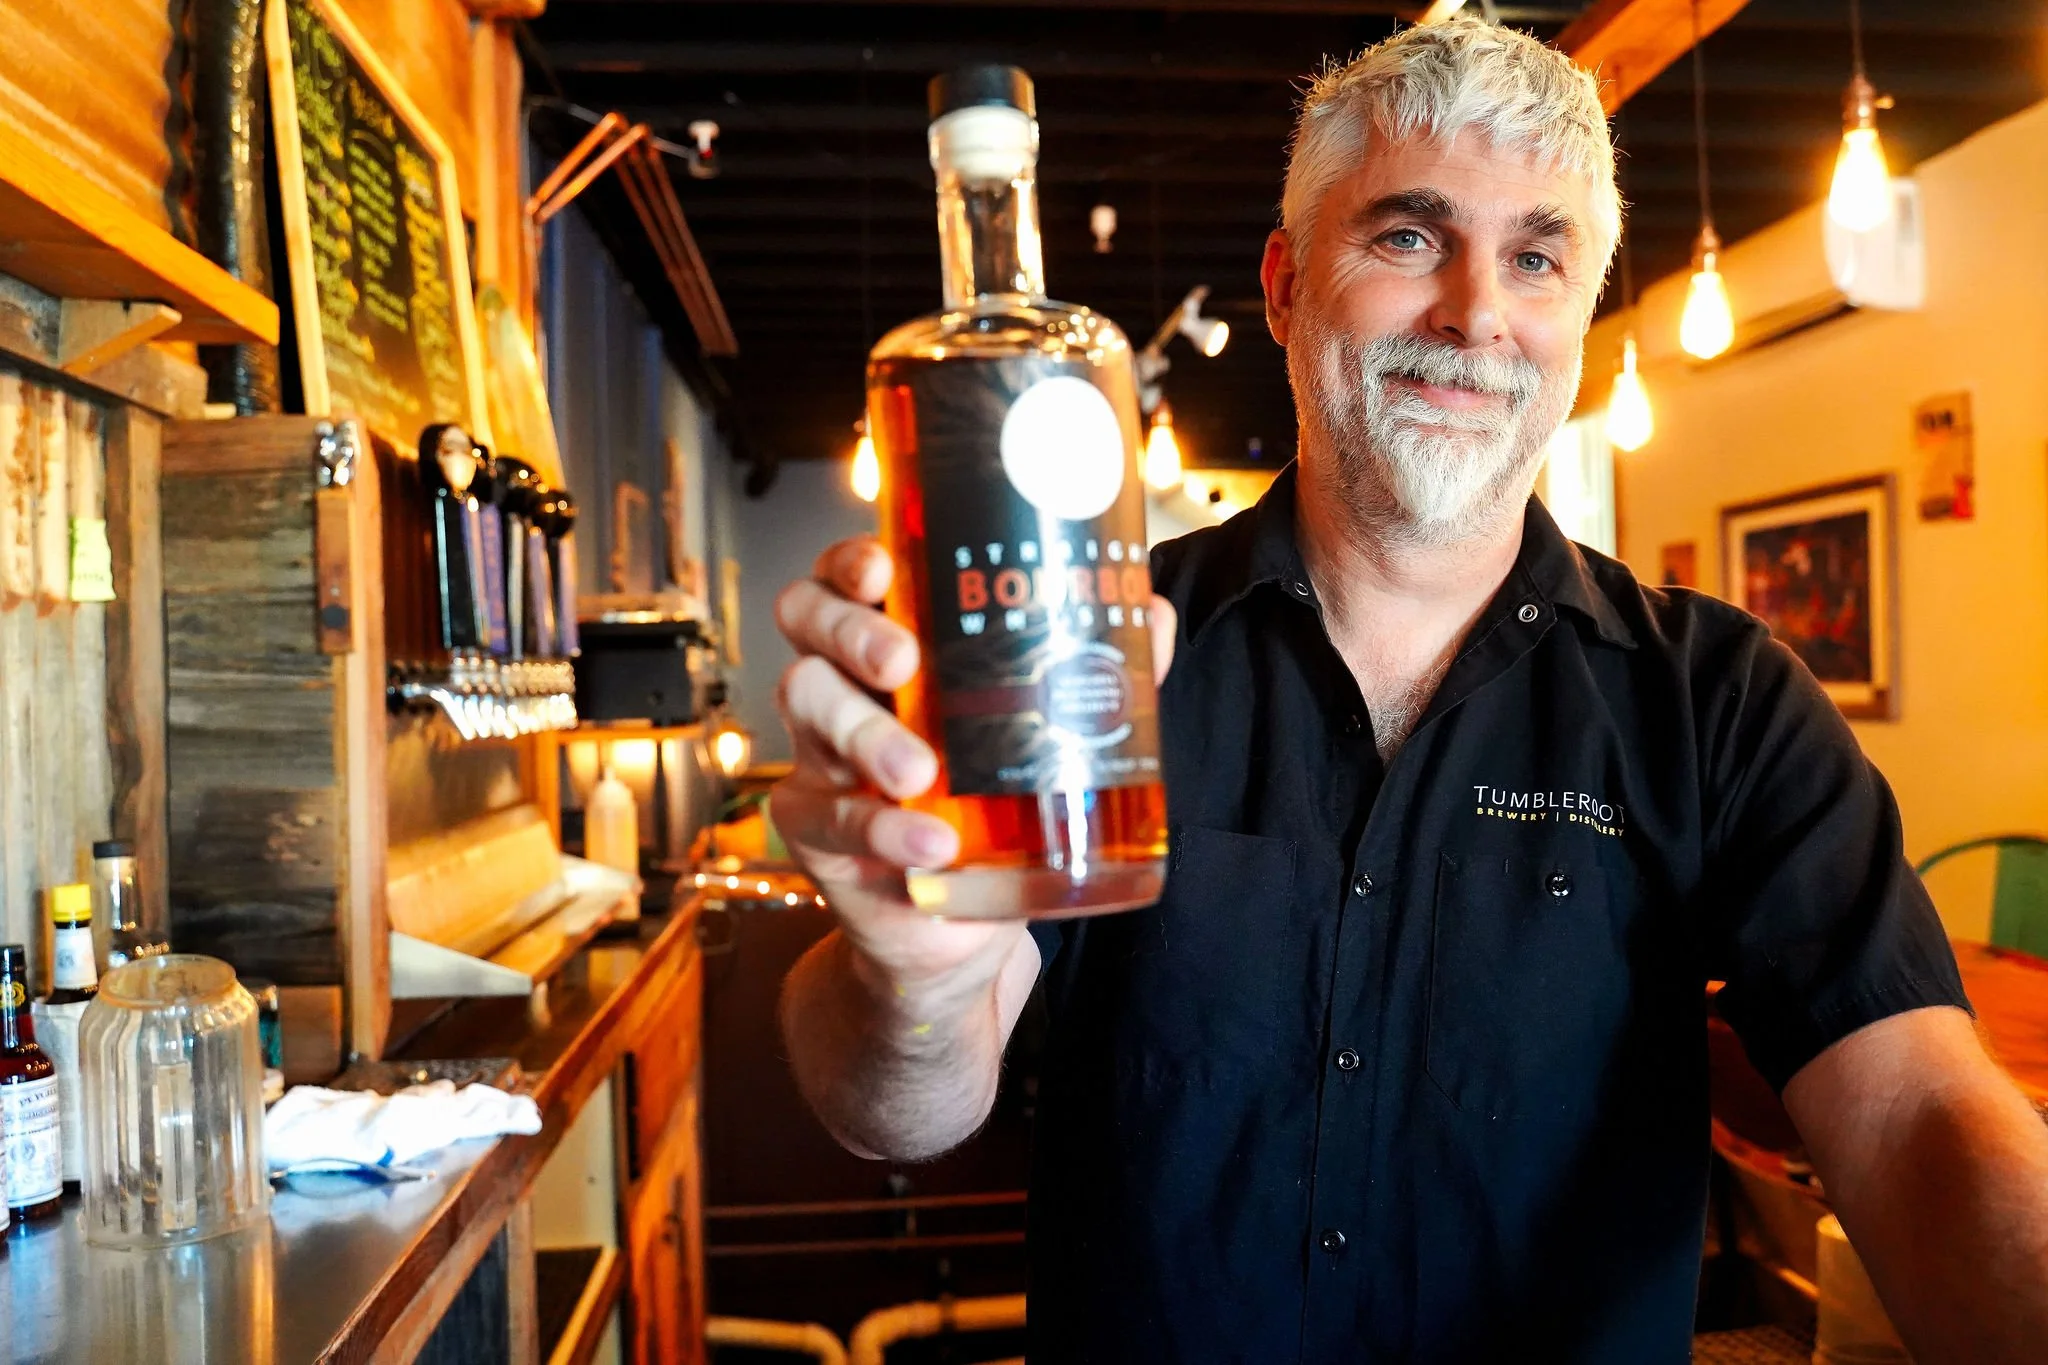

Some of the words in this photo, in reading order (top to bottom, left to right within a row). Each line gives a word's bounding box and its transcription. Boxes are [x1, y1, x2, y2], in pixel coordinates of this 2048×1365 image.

[957, 566, 1152, 611] BOURBO
[1474, 785, 1625, 824] TUMBLEROOT
[1476, 807, 1547, 821] BREWERY
